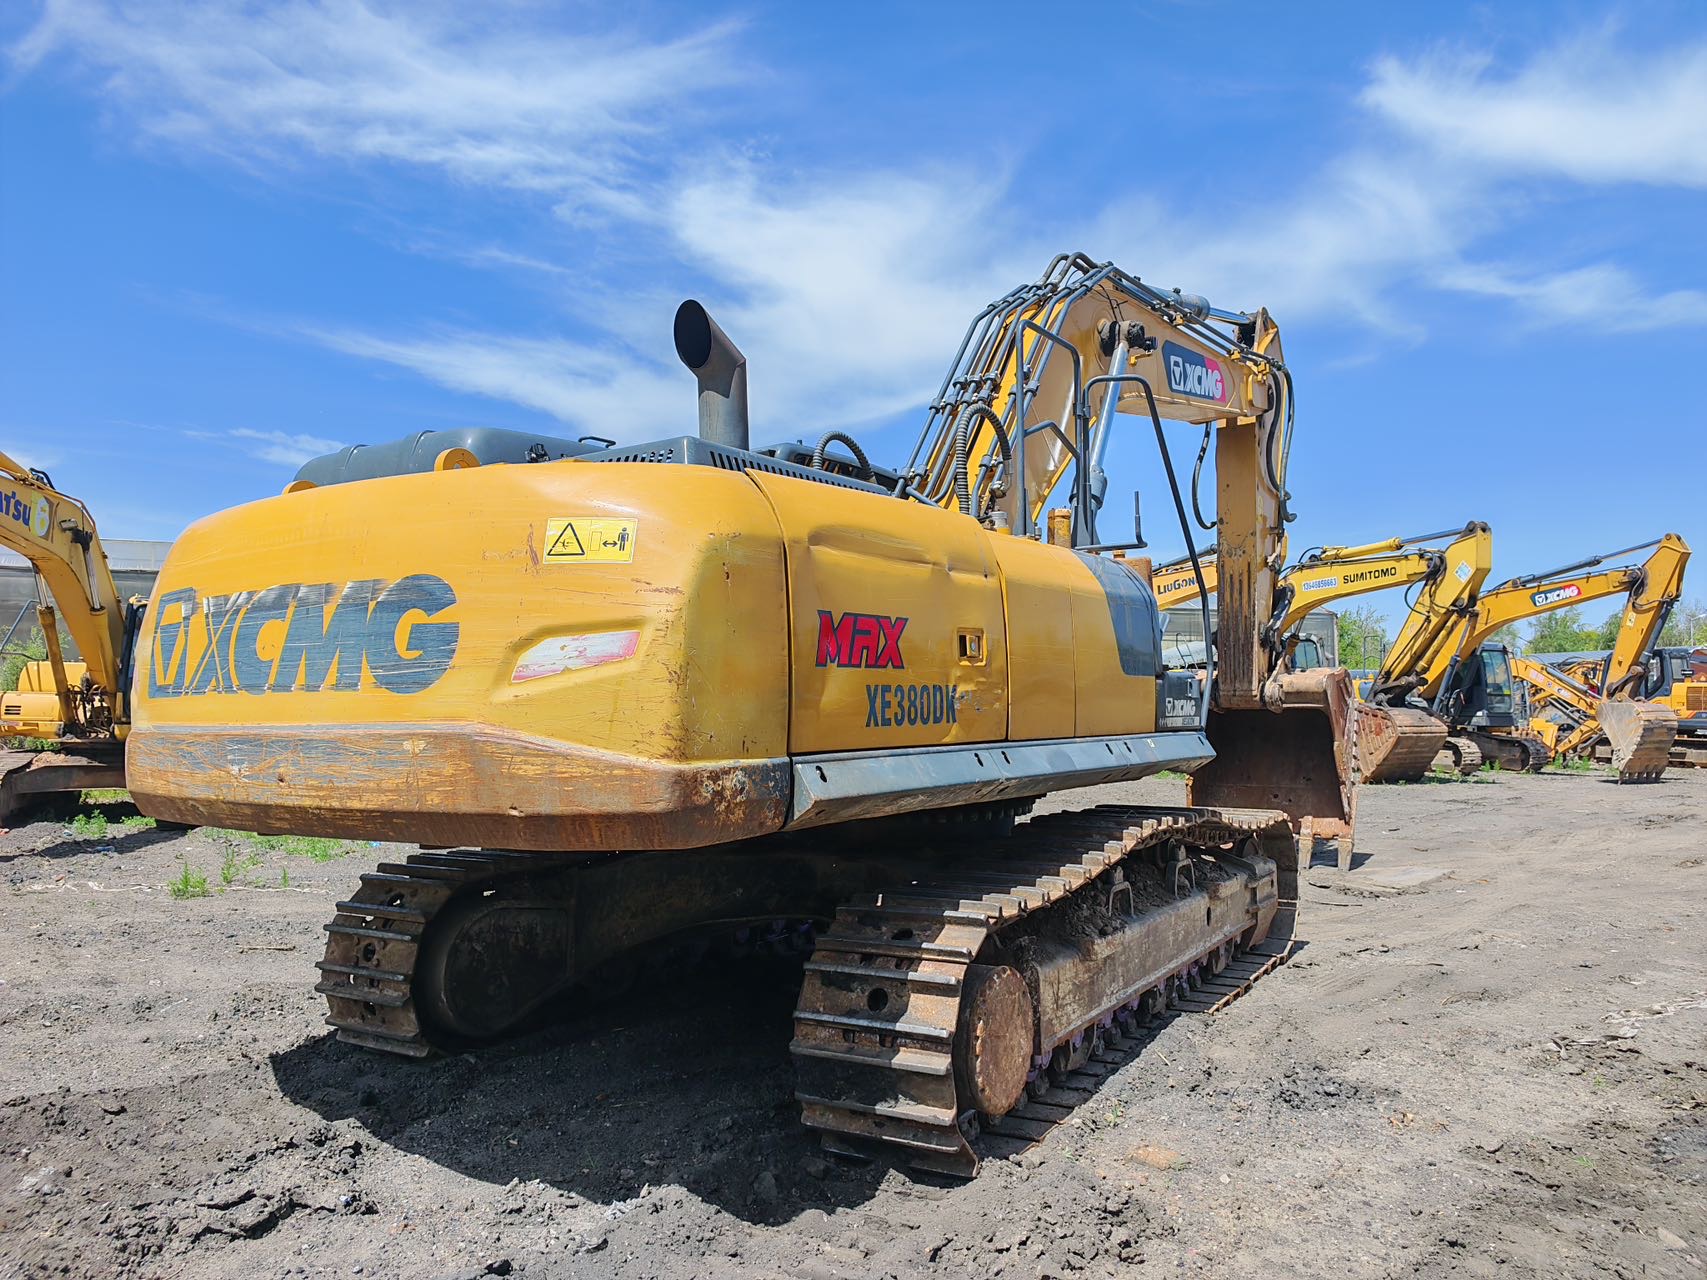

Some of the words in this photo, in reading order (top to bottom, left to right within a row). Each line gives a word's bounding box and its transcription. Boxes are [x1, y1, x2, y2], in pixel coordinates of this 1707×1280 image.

[1184, 363, 1223, 399] XCMG
[1343, 566, 1397, 584] SUMITOMO
[1545, 585, 1579, 603] XCMG
[186, 573, 461, 696] XCMG
[815, 609, 909, 669] MAX
[865, 684, 958, 728] XE380DK
[1173, 699, 1196, 717] XCMG
